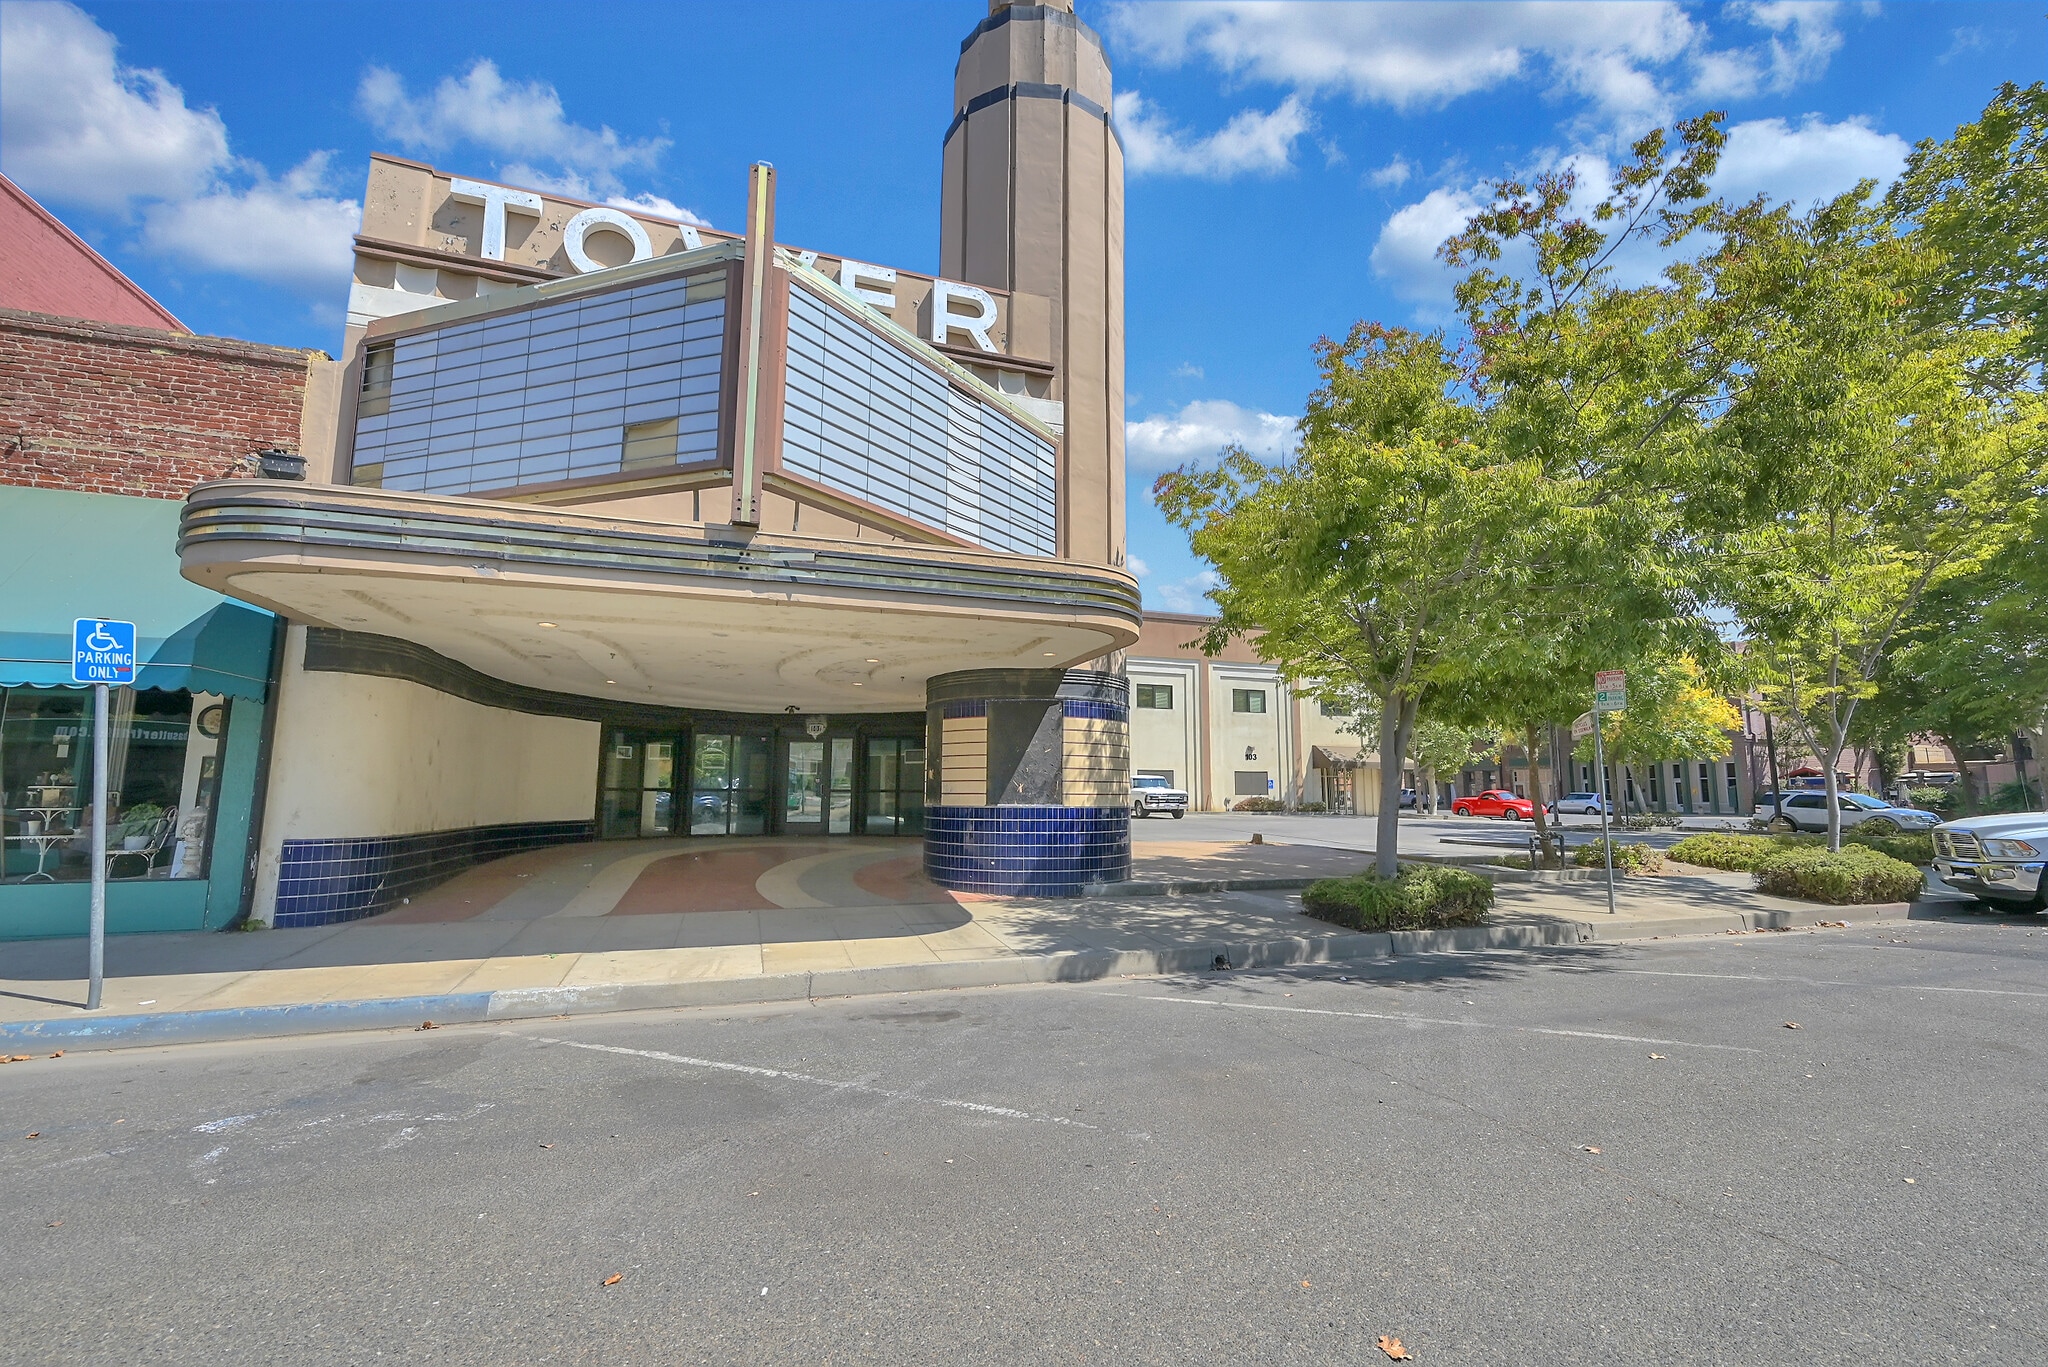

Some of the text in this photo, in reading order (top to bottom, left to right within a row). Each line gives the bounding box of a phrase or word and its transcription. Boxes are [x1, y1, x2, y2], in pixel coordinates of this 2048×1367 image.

[449, 176, 1000, 354] TOER
[77, 650, 132, 666] PARKING
[88, 665, 119, 679] ONLY
[1599, 692, 1606, 701] 2
